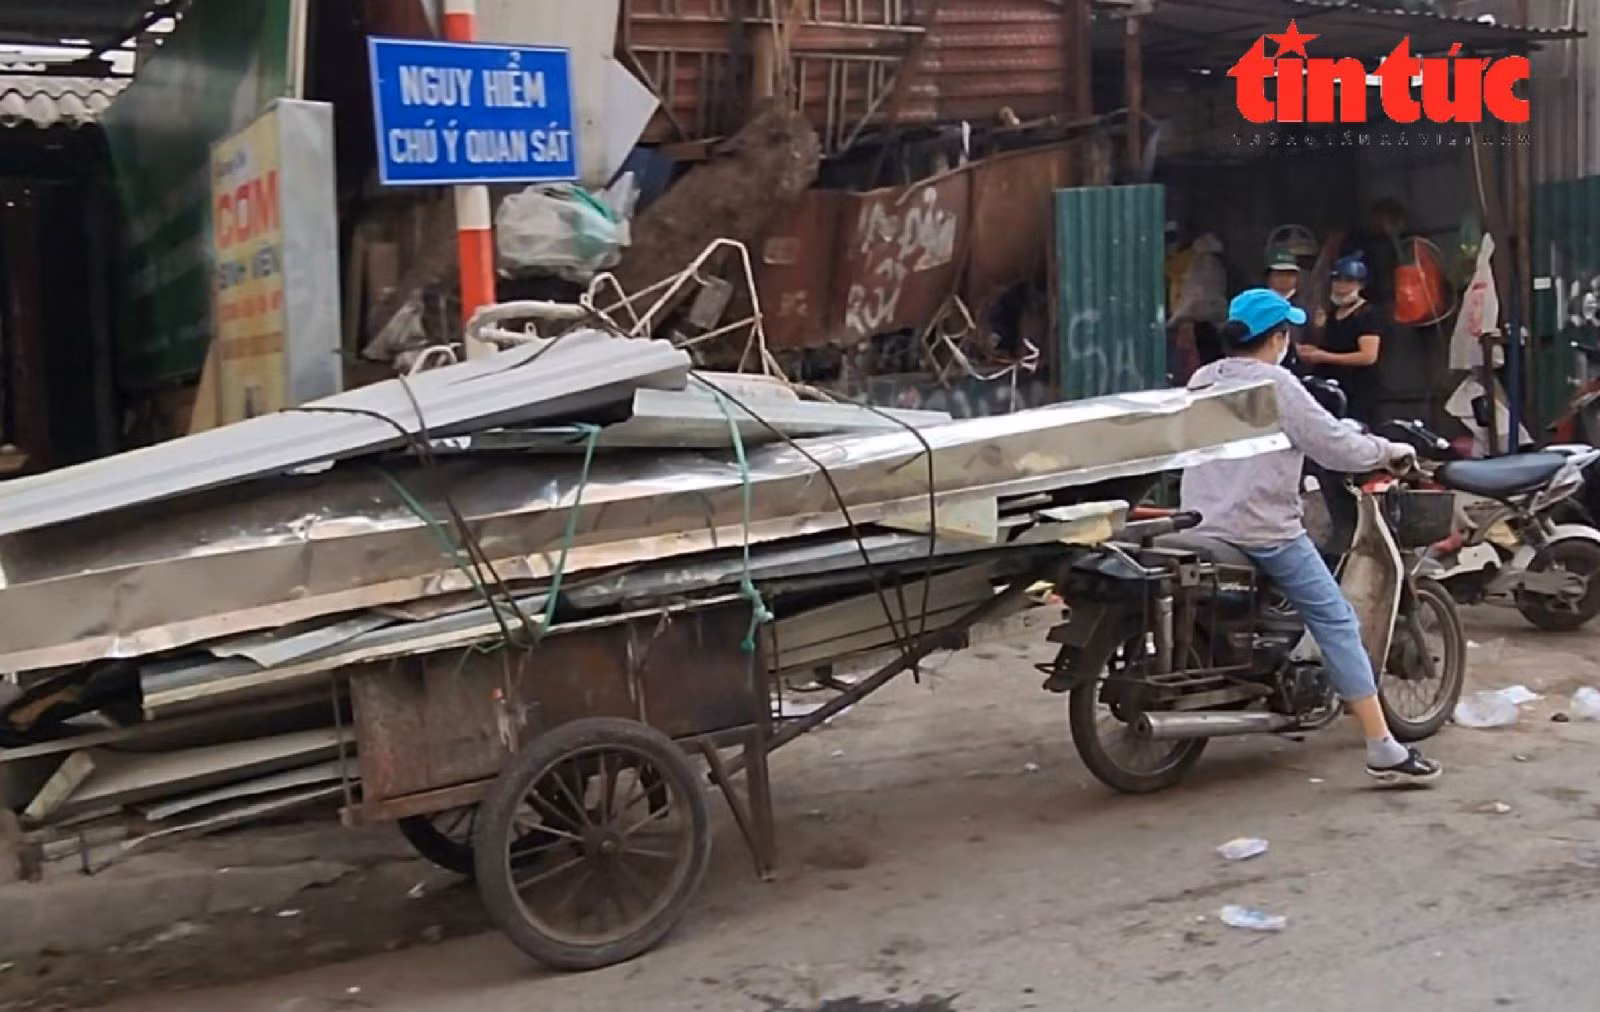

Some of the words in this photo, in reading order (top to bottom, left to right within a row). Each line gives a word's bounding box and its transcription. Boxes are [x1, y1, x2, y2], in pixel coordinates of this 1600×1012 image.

[399, 65, 473, 107] NGUY
[482, 51, 547, 108] HIỂM
[388, 119, 438, 163] CHÚ
[442, 119, 459, 163] Ý
[465, 129, 529, 163] QUAN
[530, 121, 571, 162] SÁT
